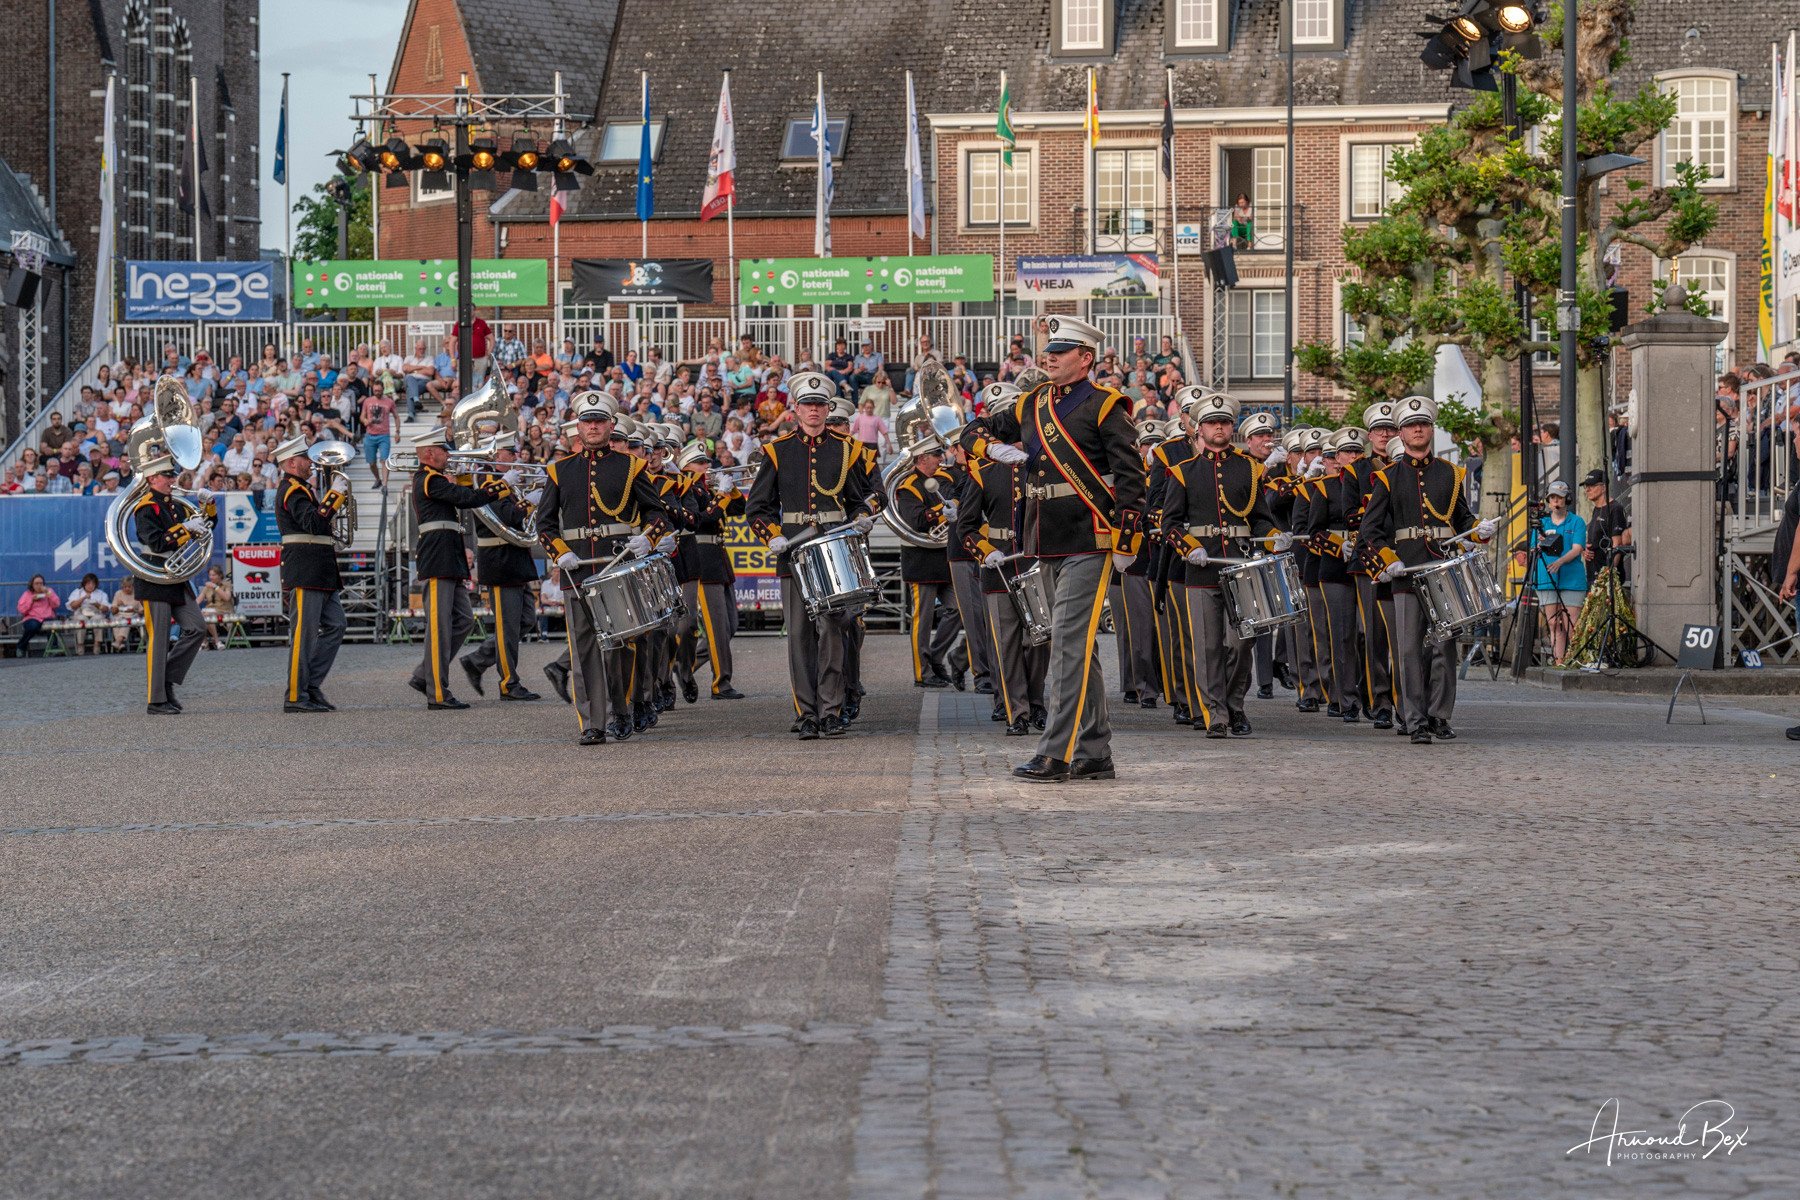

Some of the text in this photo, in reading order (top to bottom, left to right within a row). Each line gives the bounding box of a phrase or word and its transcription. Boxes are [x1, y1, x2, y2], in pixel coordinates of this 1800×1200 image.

[1022, 260, 1031, 269] De
[1031, 260, 1048, 269] basis
[1048, 261, 1061, 269] voor
[1062, 260, 1078, 269] ieder
[356, 271, 404, 280] nationale
[802, 268, 850, 278] nationale
[915, 266, 963, 276] nationale
[356, 282, 386, 293] loterij
[802, 279, 833, 291] loterij
[915, 277, 946, 289] loterij
[1024, 277, 1074, 292] VAHEJA
[130, 265, 269, 316] hegge
[1062, 463, 1094, 500] RIJNMONDBAND
[239, 550, 276, 559] DEUREN
[235, 591, 280, 600] VERDUYCKT
[757, 588, 781, 600] MEER
[1685, 627, 1714, 649] 50
[1743, 651, 1762, 667] 30
